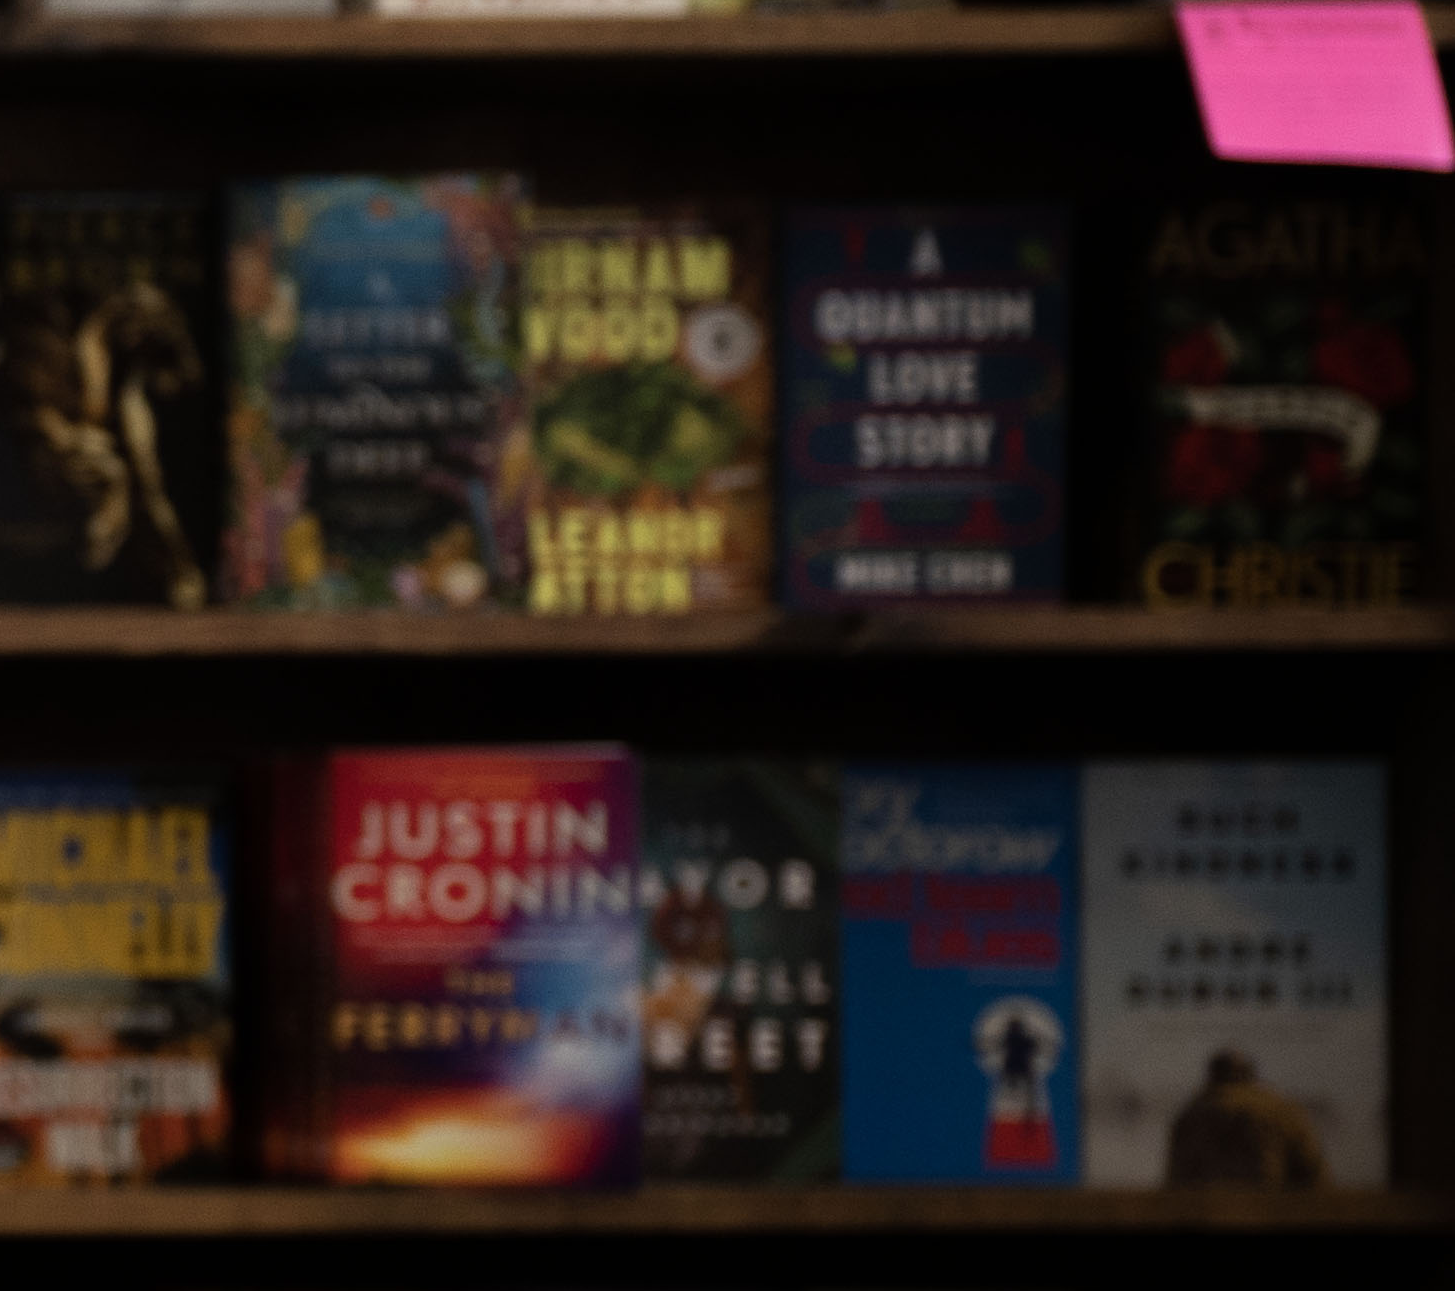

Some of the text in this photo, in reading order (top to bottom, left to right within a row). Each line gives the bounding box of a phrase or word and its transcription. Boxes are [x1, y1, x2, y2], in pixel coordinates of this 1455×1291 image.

[906, 227, 948, 274] A
[1148, 204, 1428, 275] AGATHA
[813, 287, 1035, 342] QUANTUM
[867, 351, 982, 404] LOVE
[853, 414, 997, 468] STORY
[524, 509, 722, 555] LEANOR
[530, 568, 692, 614] ATTON
[1143, 543, 1416, 607] CHRISTIE
[354, 798, 607, 860] JUSTIN
[1176, 804, 1301, 834] SUCH
[637, 858, 818, 908] AYOR
[1120, 850, 1359, 879] KINDNESS
[333, 862, 634, 922] CRONIN
[332, 1001, 630, 1052] FERRYMAN
